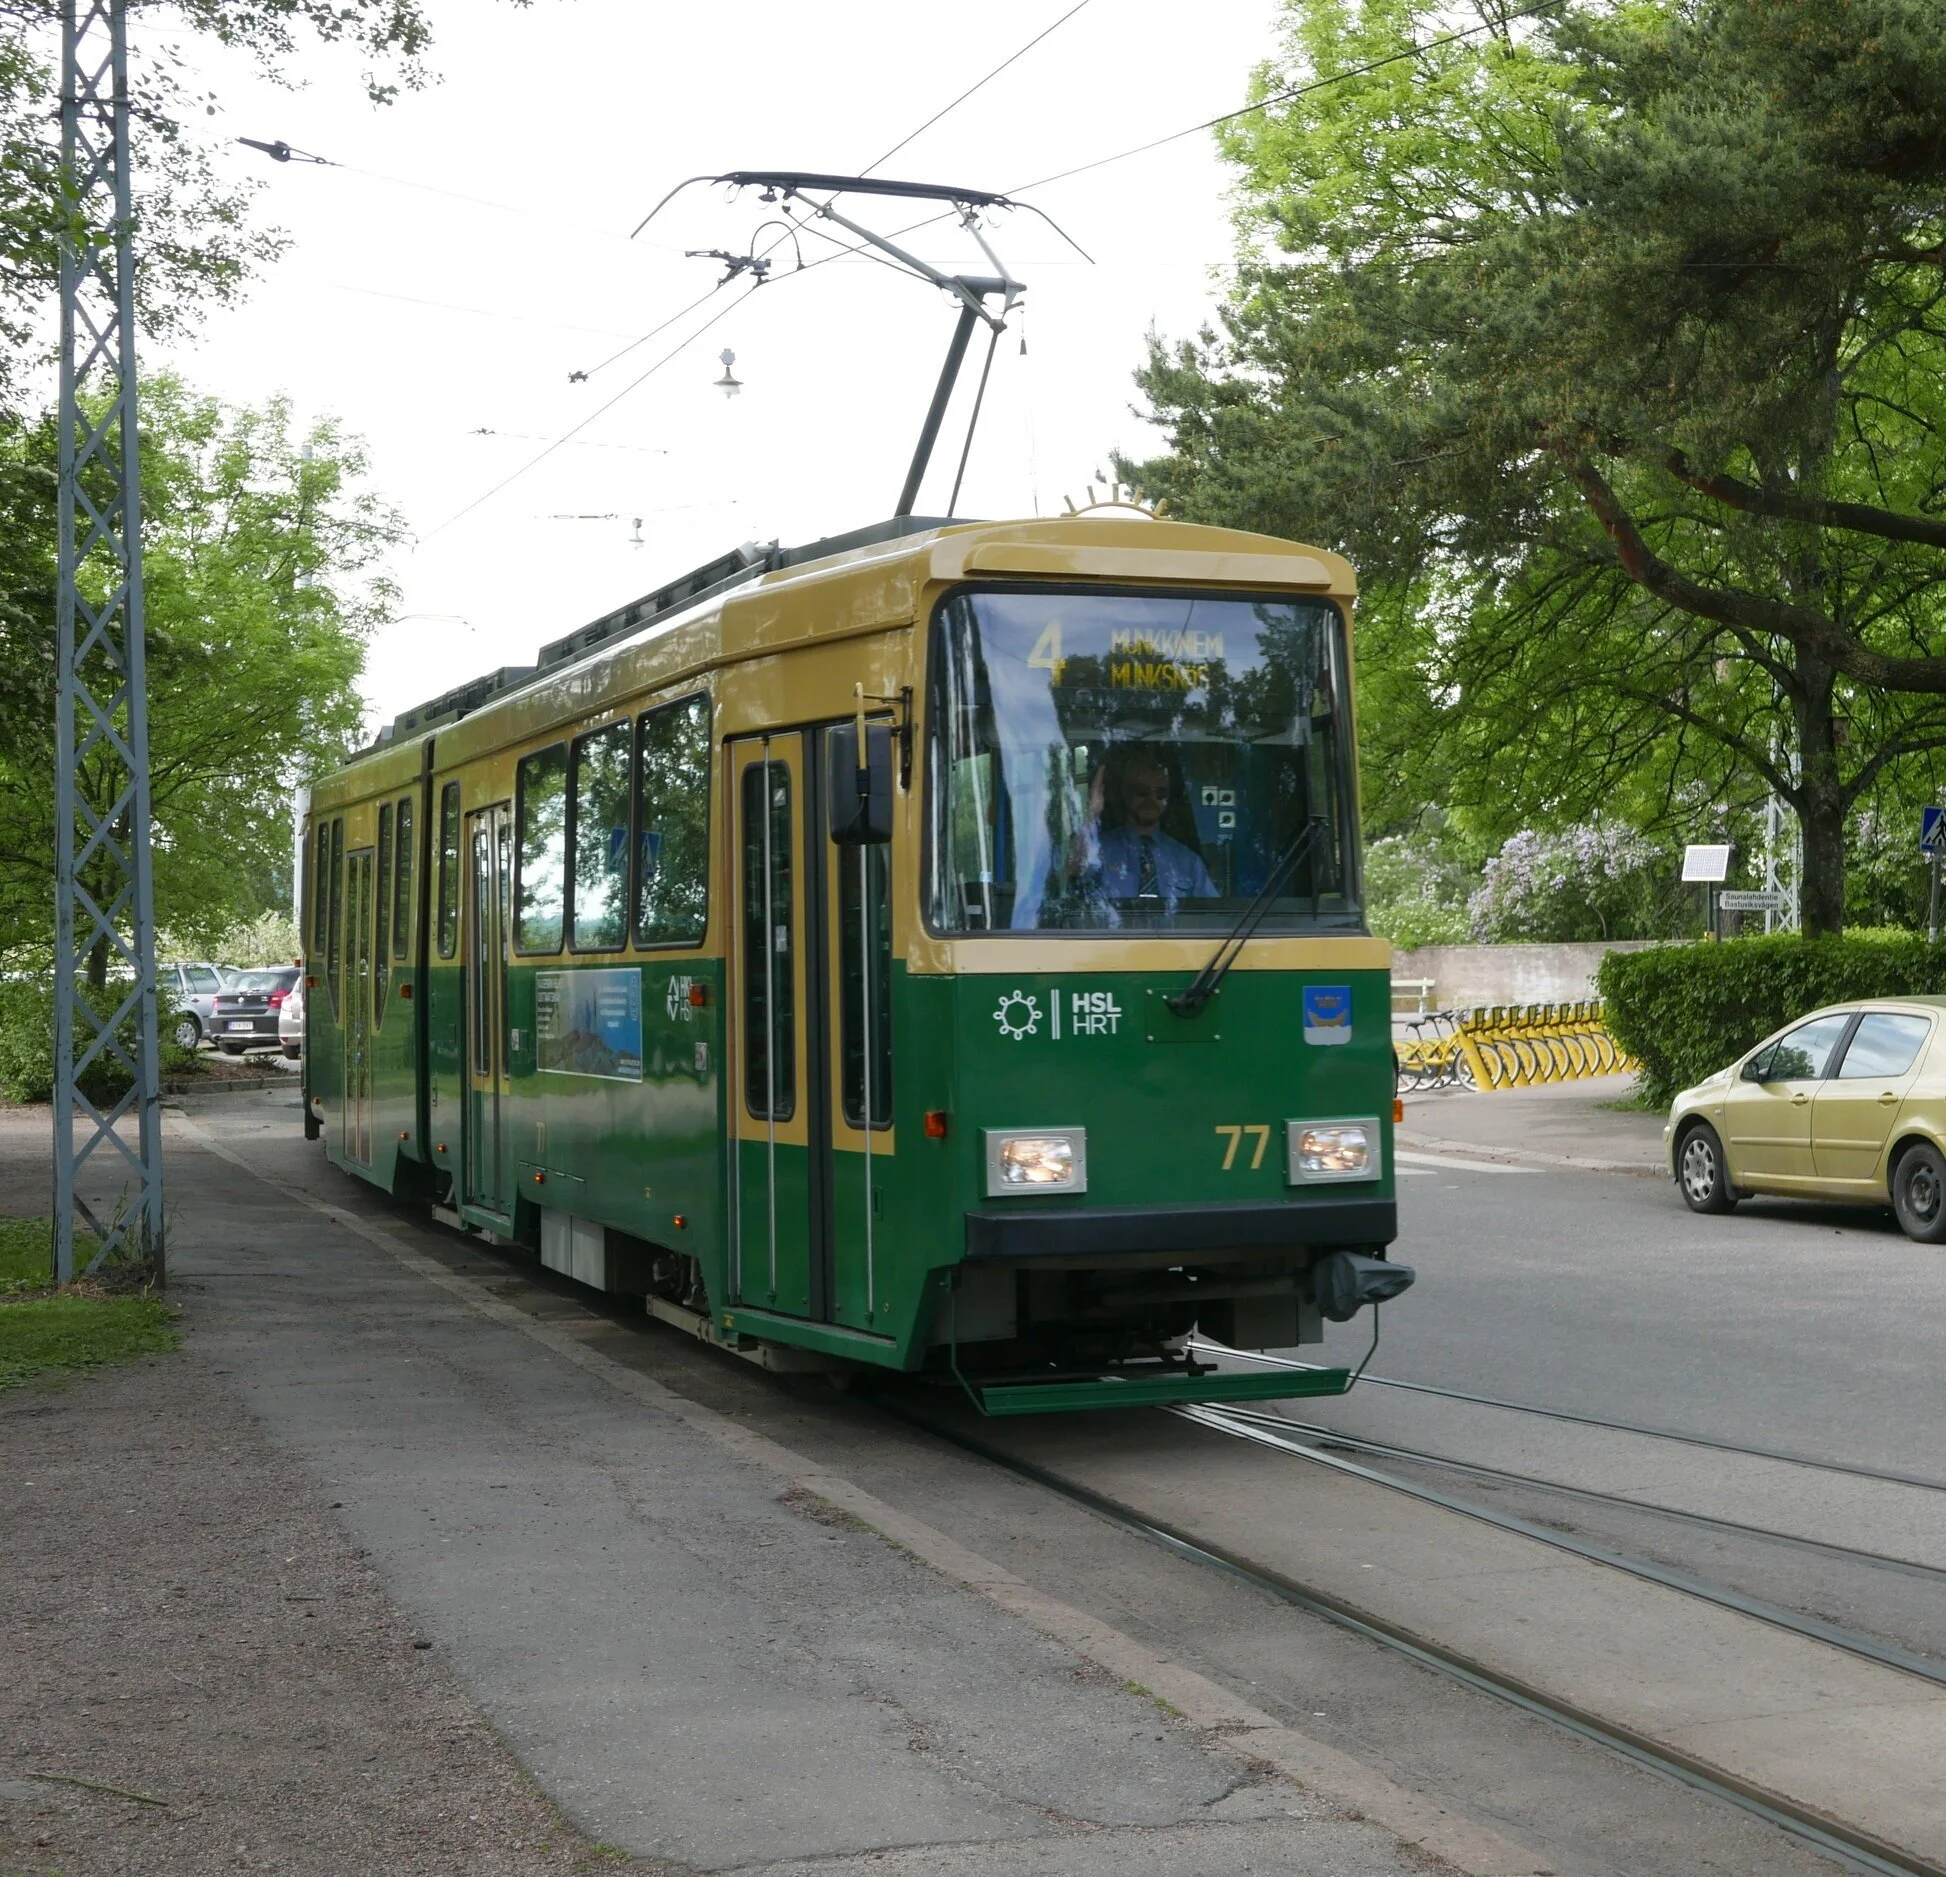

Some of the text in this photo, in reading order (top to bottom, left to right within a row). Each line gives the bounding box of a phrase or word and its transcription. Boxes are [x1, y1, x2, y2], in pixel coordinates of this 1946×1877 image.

[1027, 618, 1067, 688] 4
[1724, 900, 1779, 909] Bastuviksvägen
[1725, 892, 1779, 901] Saunalahdentie
[1072, 992, 1121, 1013] HSL
[1072, 1014, 1121, 1035] HRT
[1215, 1125, 1270, 1169] 77
